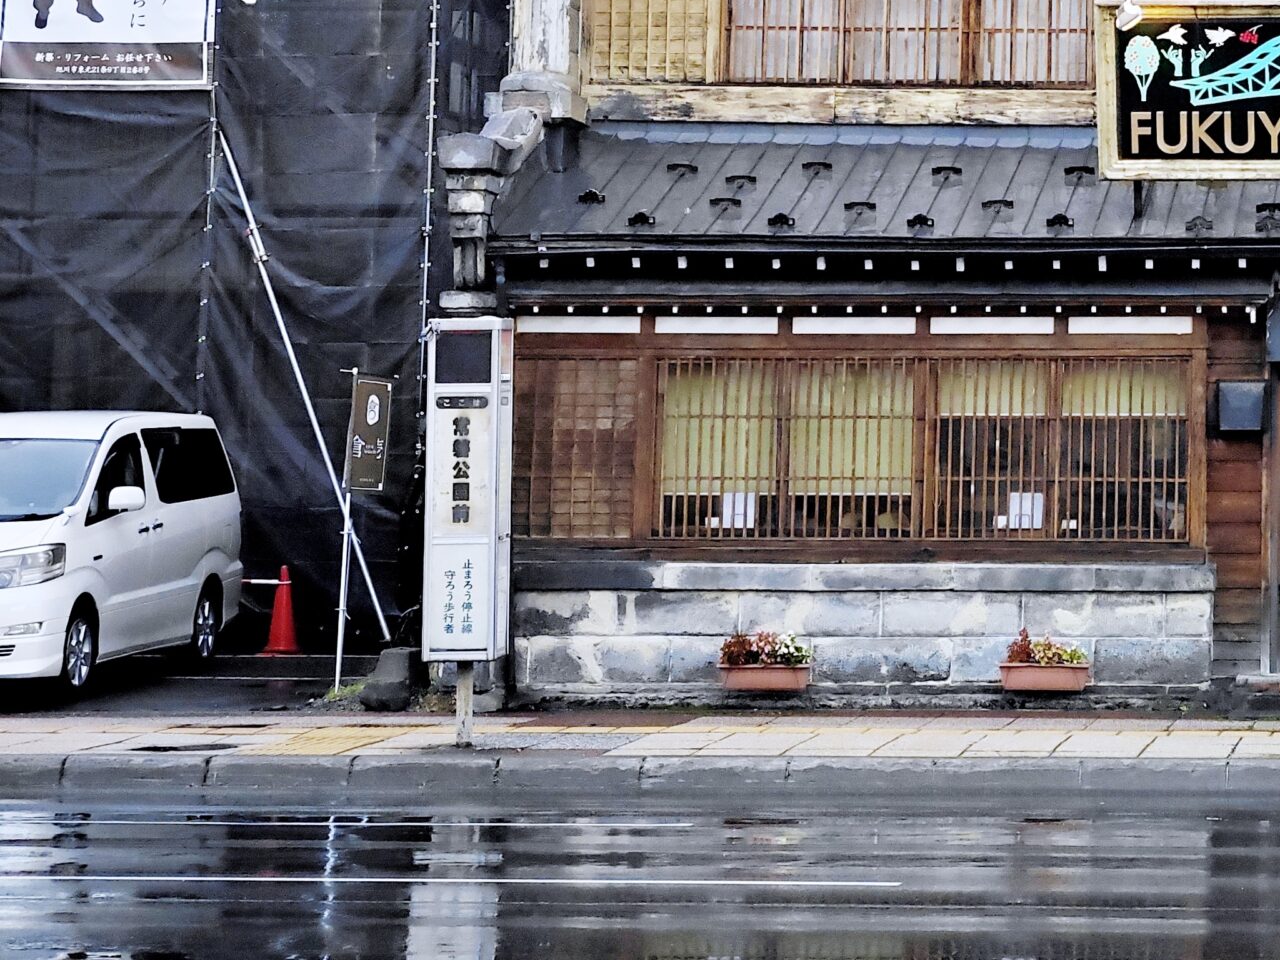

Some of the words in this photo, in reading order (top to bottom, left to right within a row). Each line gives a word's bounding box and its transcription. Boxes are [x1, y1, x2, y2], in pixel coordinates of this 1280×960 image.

[443, 570, 456, 635] 守ろう歩行者
[461, 558, 474, 635] 止まろう停止線
